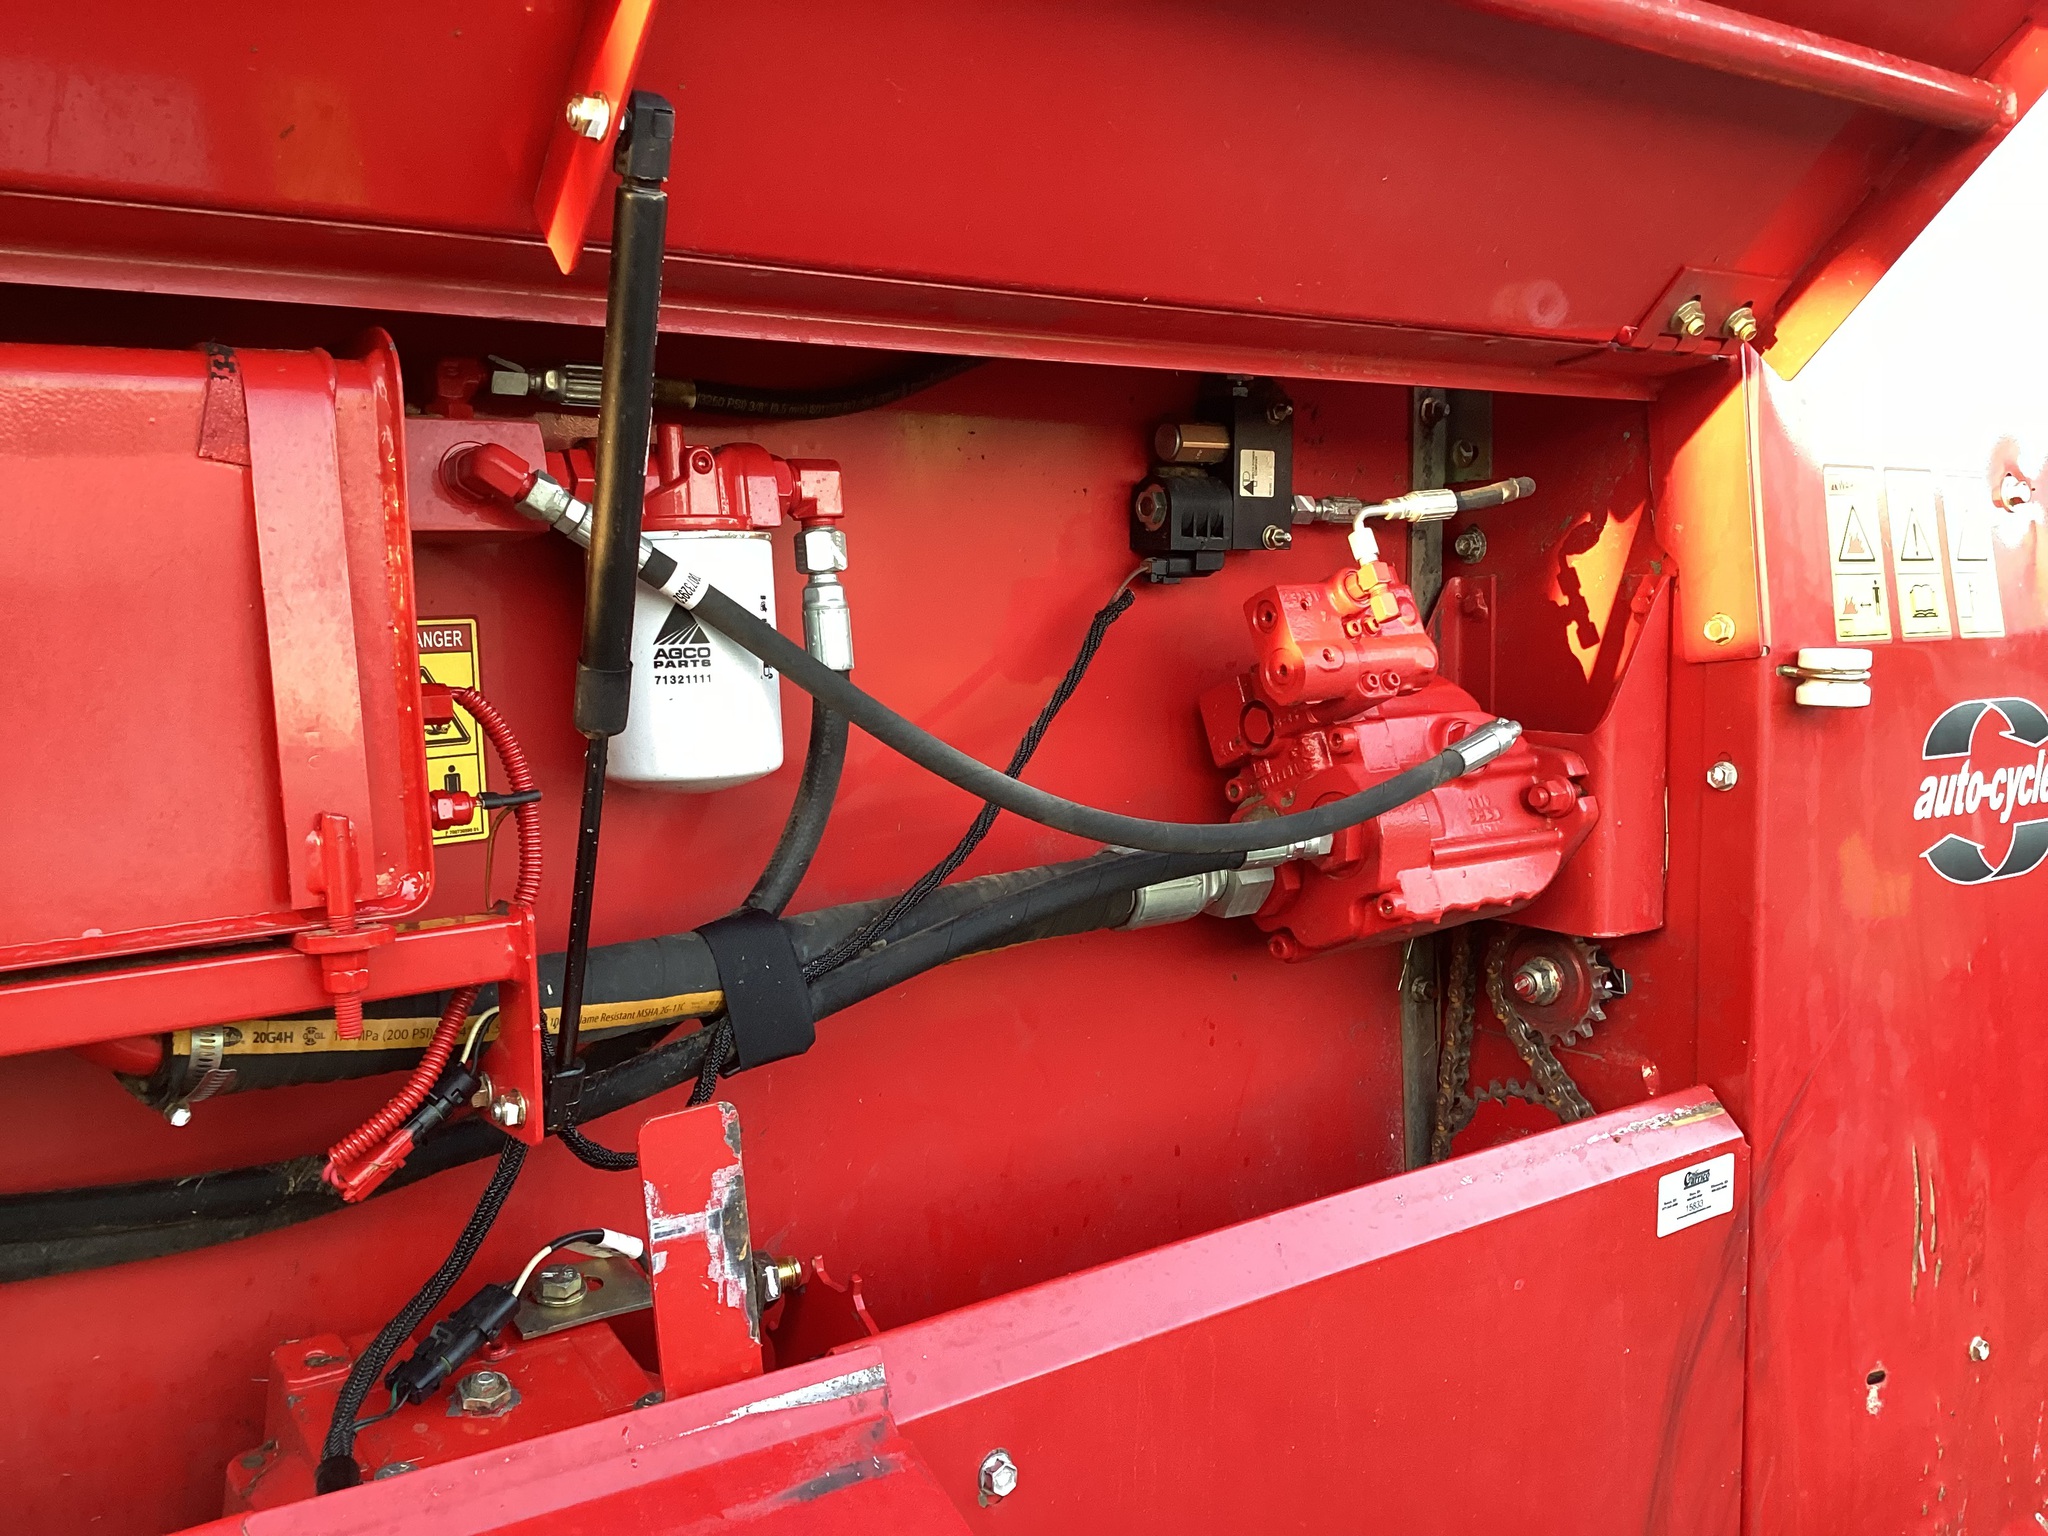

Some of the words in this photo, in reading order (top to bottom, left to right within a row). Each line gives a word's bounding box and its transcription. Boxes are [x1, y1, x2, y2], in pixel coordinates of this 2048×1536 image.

[416, 629, 464, 648] ANGER
[653, 647, 711, 660] AGCO
[653, 659, 711, 669] PARTS
[654, 674, 711, 685] 71321111
[579, 1014, 600, 1025] lame
[600, 1010, 636, 1023] Resistant
[636, 1006, 659, 1018] MSHA
[252, 1031, 294, 1044] 20G4H
[383, 1029, 409, 1042] (200
[411, 1027, 434, 1040] PSI)
